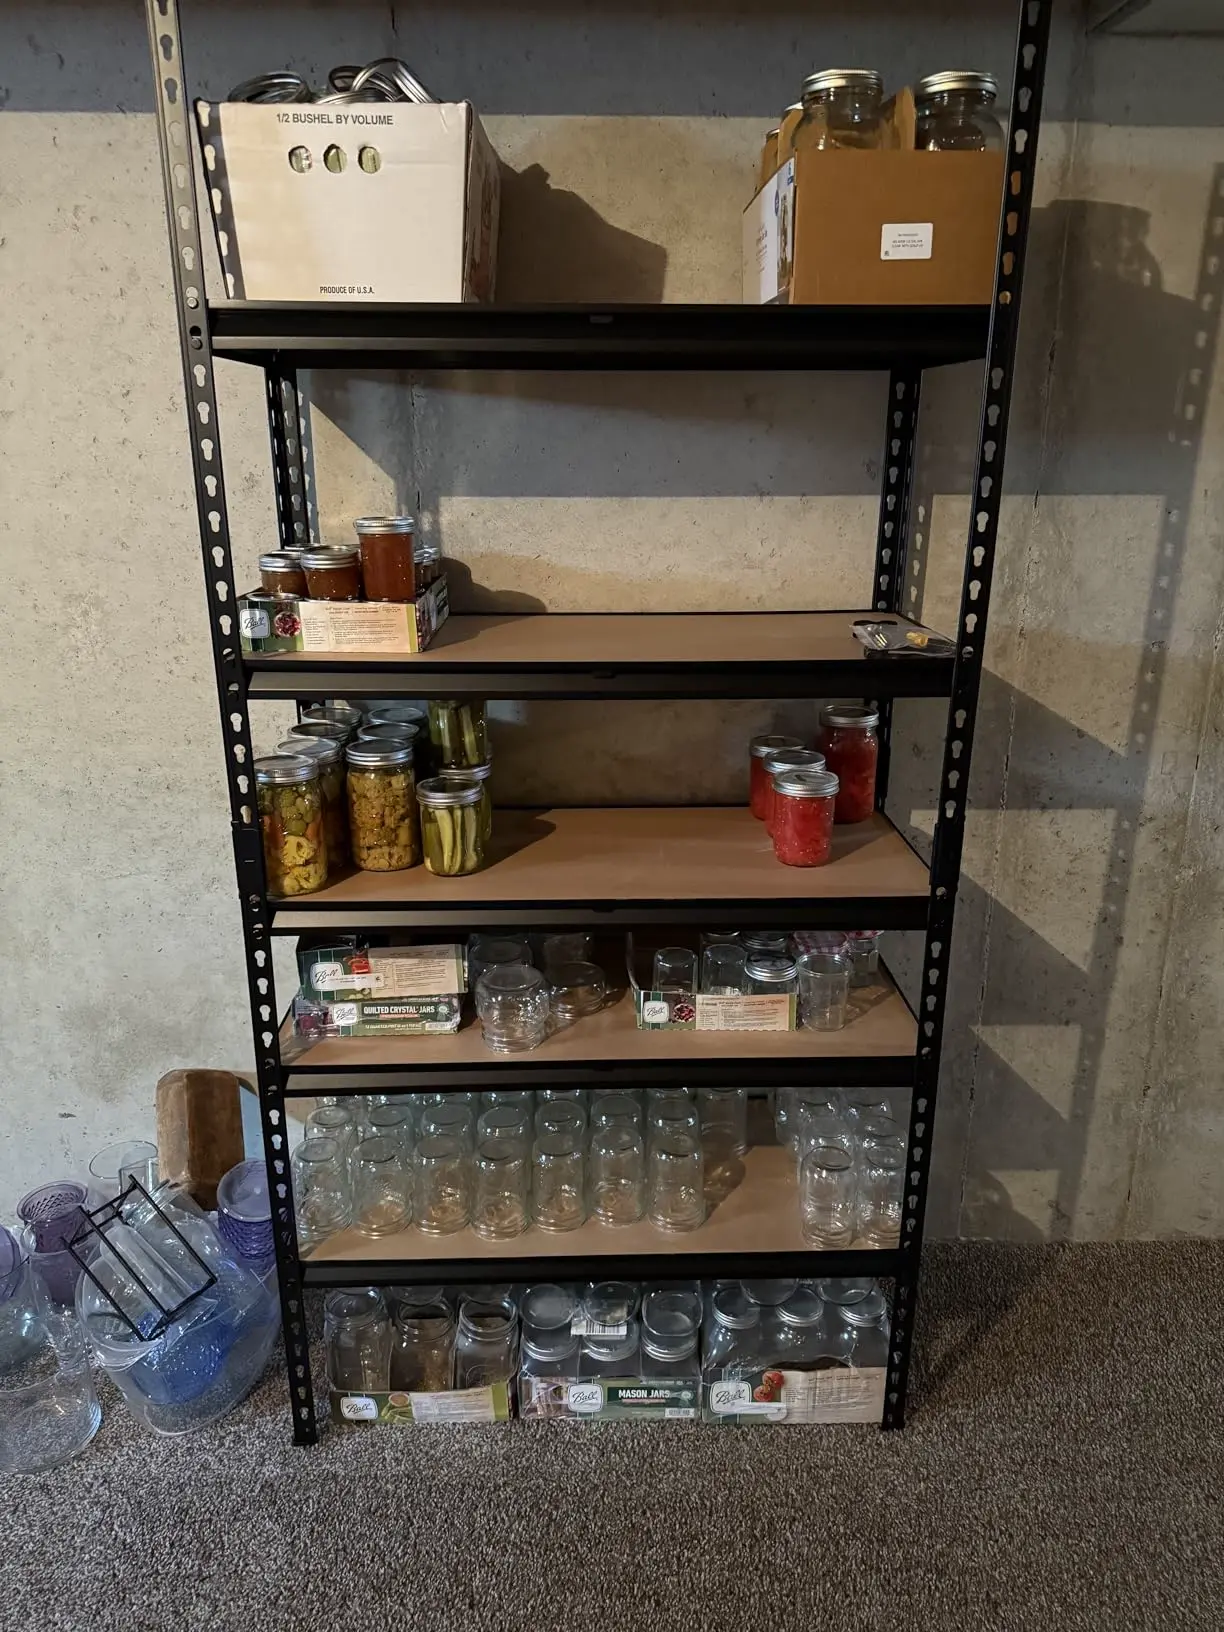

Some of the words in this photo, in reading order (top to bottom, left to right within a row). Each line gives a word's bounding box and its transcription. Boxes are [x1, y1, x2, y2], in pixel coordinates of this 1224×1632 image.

[276, 113, 290, 124] 1/2
[292, 114, 333, 124] BUSHEL
[335, 114, 350, 125] BY
[350, 114, 394, 125] VOLUME
[319, 286, 347, 295] PRODUCE
[348, 286, 356, 295] OF
[356, 286, 375, 295] U.S.A.
[244, 616, 266, 630] Ball
[363, 1005, 389, 1014] QUILTED
[418, 1005, 435, 1014] JARS
[573, 1391, 599, 1403] Ball
[618, 1389, 648, 1399] MASON
[648, 1389, 671, 1399] JARS
[716, 1389, 745, 1403] Ball
[346, 1403, 371, 1414] Ball
